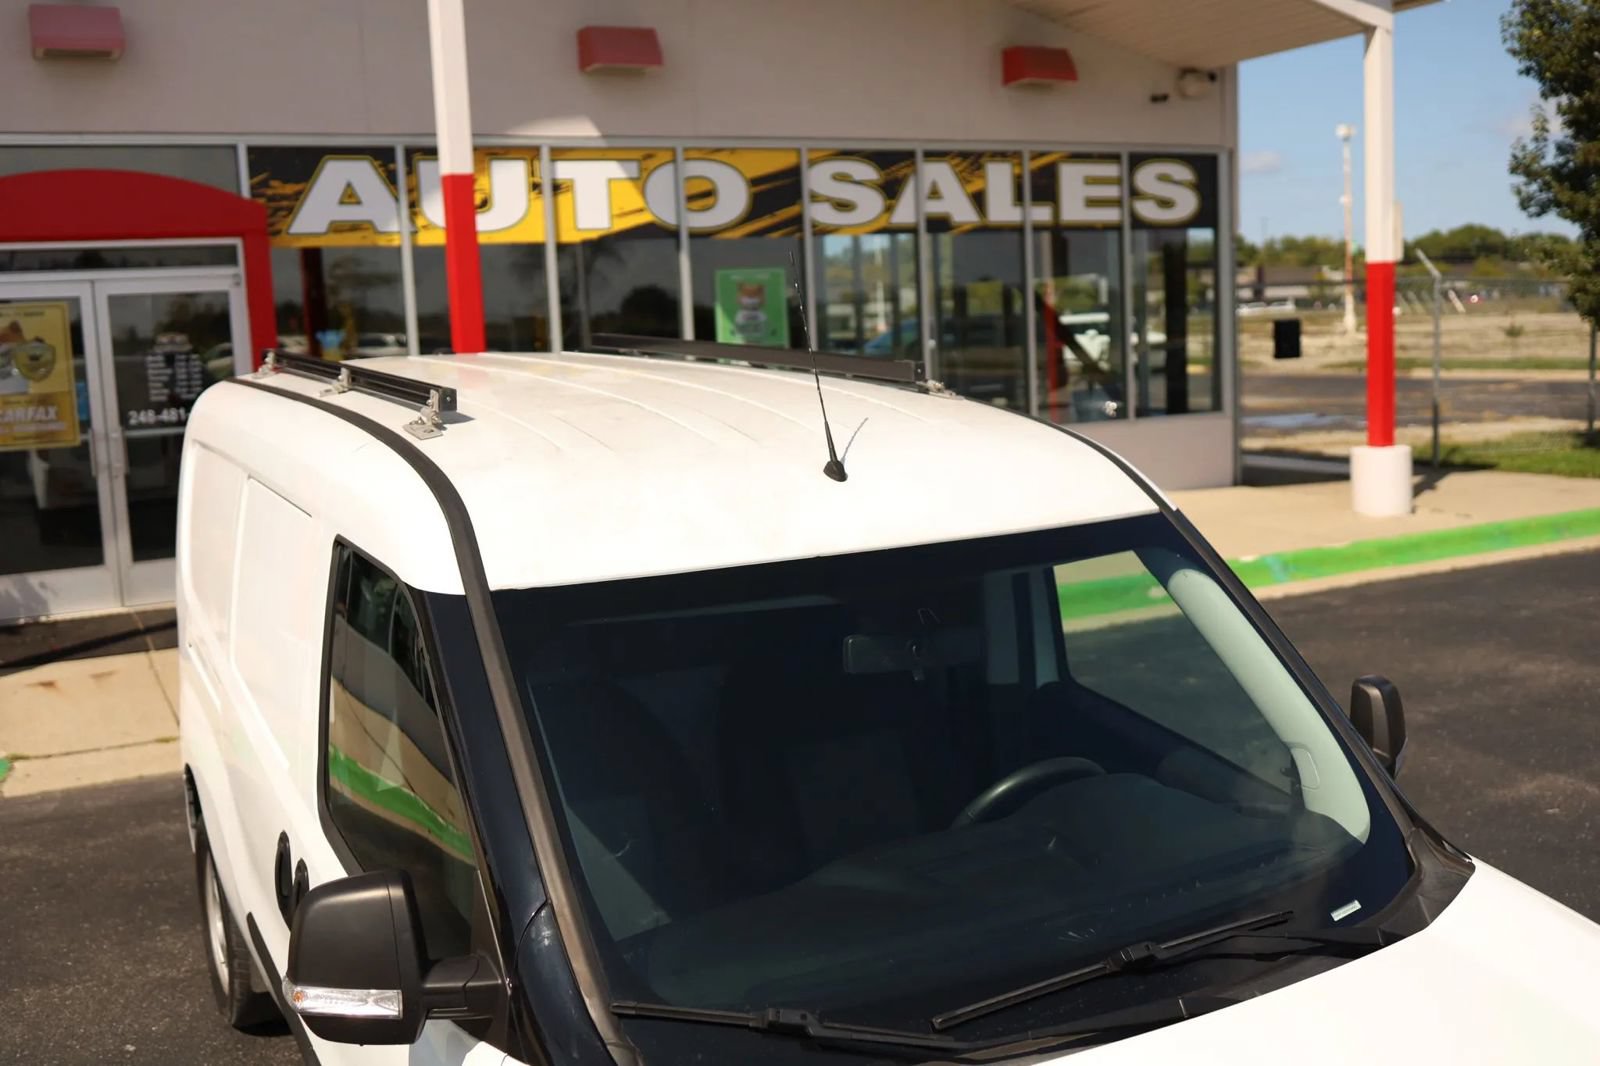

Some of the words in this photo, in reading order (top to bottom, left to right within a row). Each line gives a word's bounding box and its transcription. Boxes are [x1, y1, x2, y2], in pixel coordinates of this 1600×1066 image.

[287, 156, 750, 235] AUTO
[805, 158, 1200, 226] SALES
[0, 406, 58, 422] ARFAX
